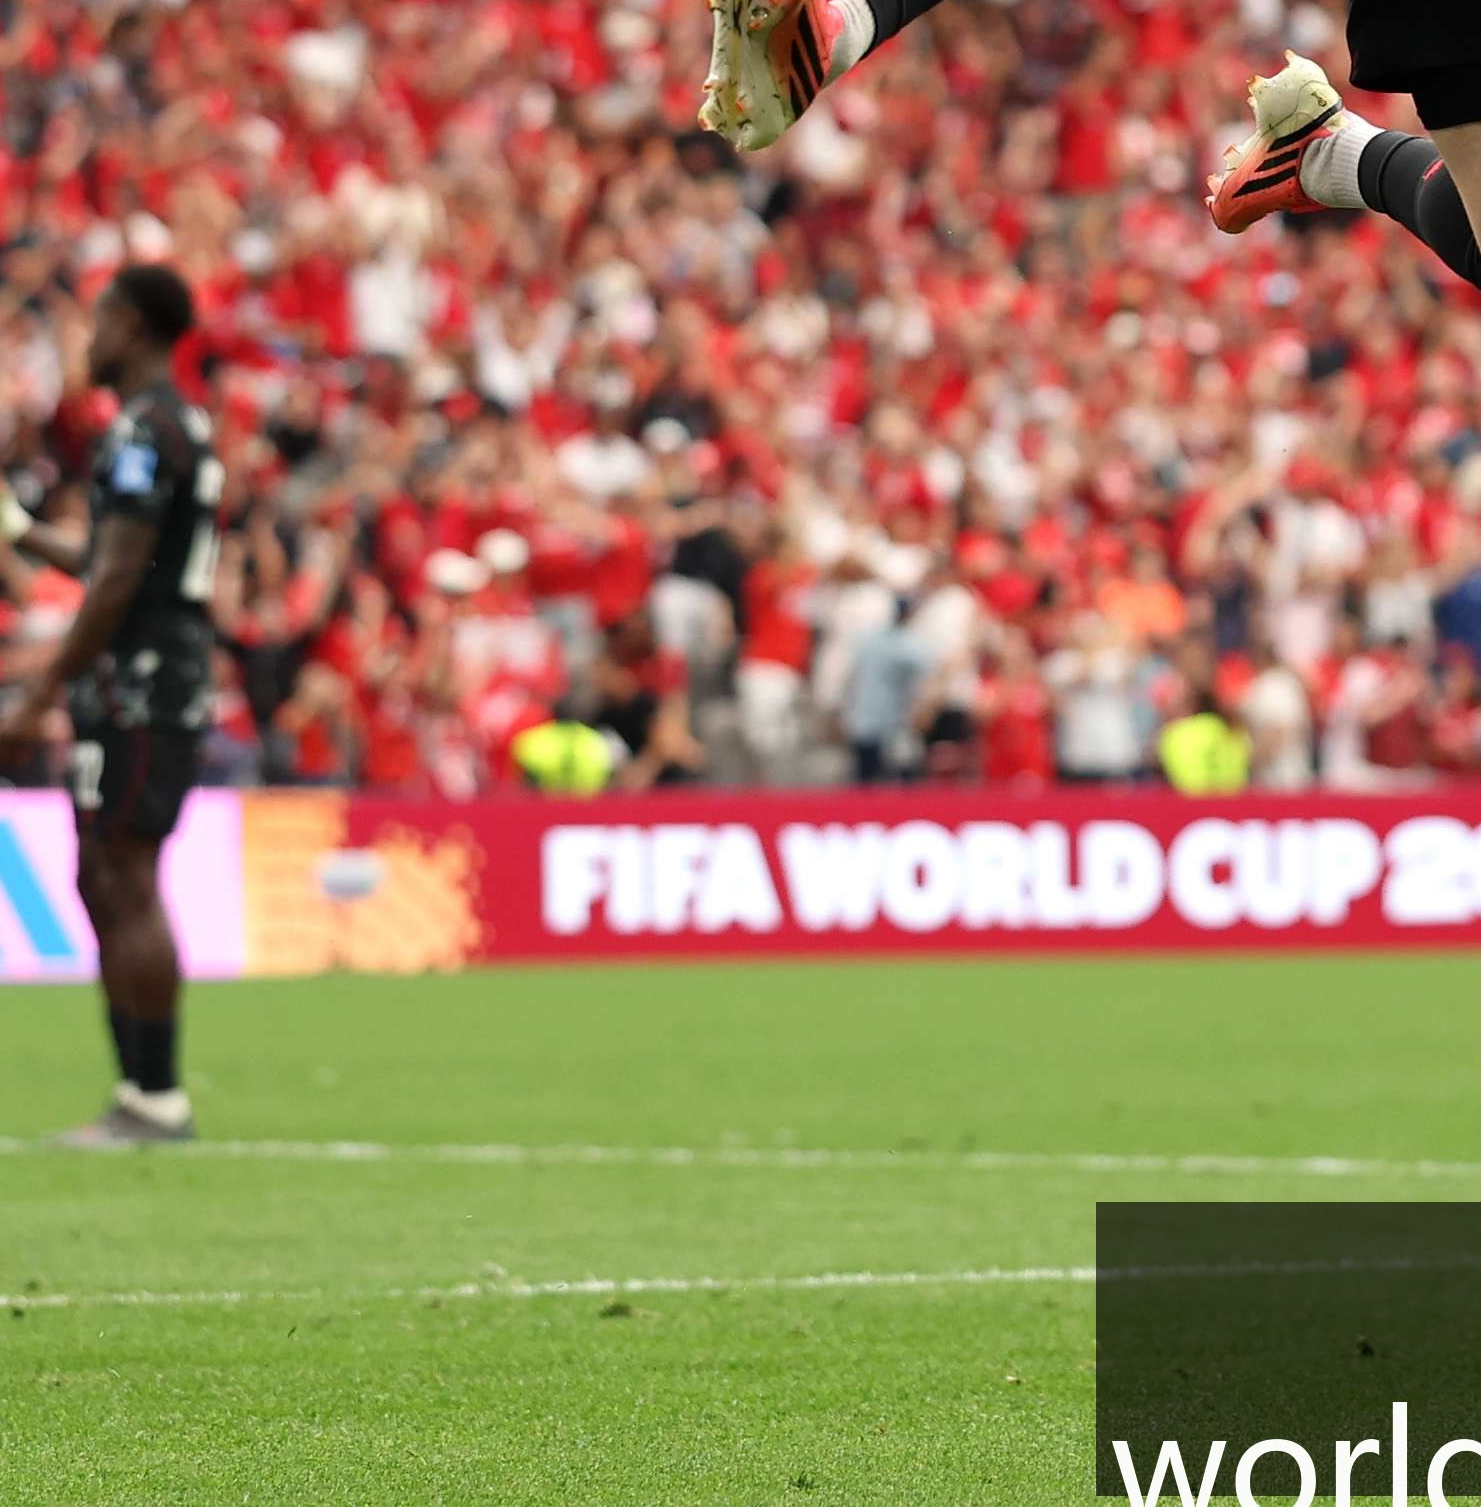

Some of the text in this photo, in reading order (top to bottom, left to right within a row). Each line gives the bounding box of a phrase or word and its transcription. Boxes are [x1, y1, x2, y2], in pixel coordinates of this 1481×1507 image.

[541, 823, 784, 936] FIFA
[776, 819, 1166, 934] WORLD
[1167, 817, 1383, 931] CUP
